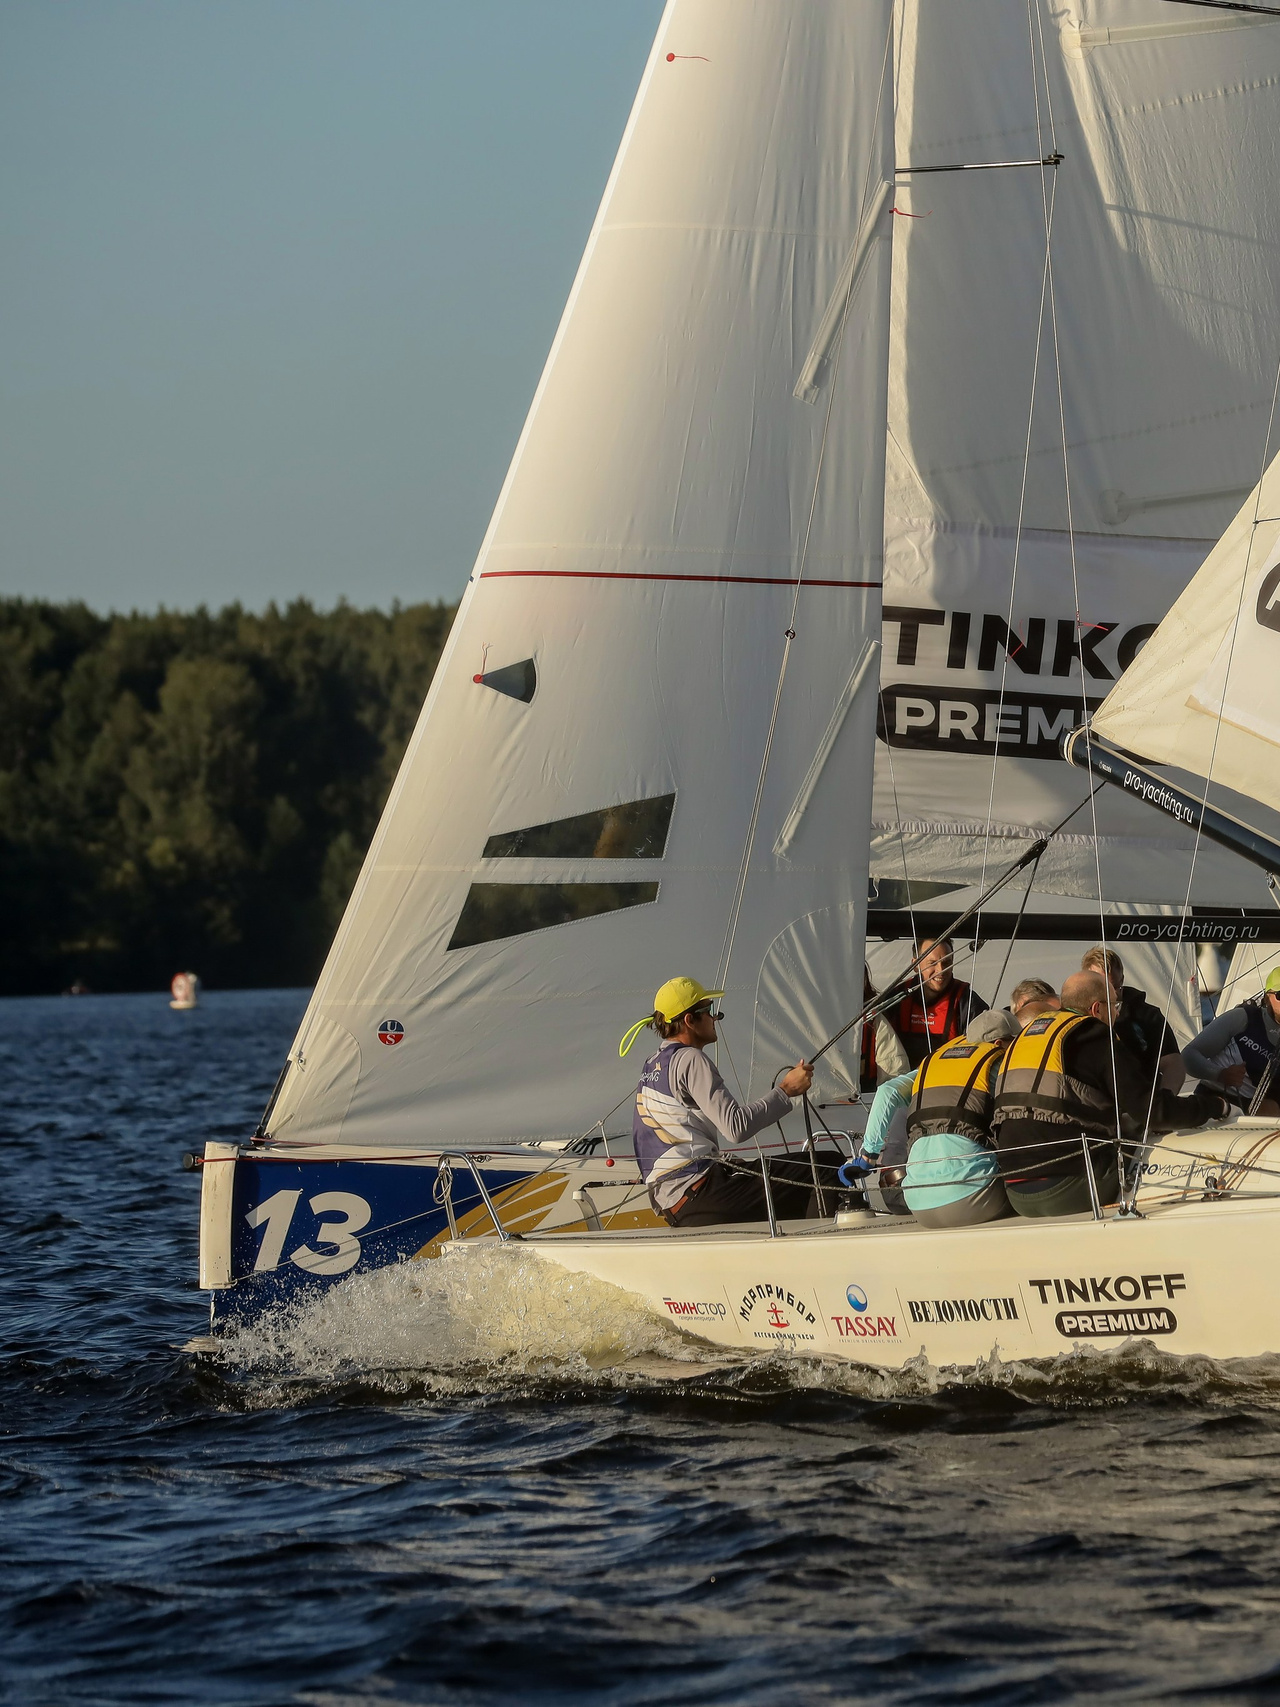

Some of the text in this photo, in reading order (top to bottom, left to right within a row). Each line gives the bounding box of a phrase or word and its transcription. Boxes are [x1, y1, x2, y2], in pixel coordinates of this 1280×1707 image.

[895, 696, 1093, 746] PREM
[1123, 770, 1195, 824] pro-yachting.ru
[1116, 921, 1260, 942] pro-yachting.ru
[244, 1189, 372, 1276] 13
[739, 1283, 817, 1324] МОРПРИБОР
[1029, 1273, 1187, 1304] TINKOFF
[831, 1316, 898, 1337] TASSAY
[907, 1297, 1020, 1325] ВЕДОМОСТИ
[1062, 1312, 1170, 1333] PREMIUM
